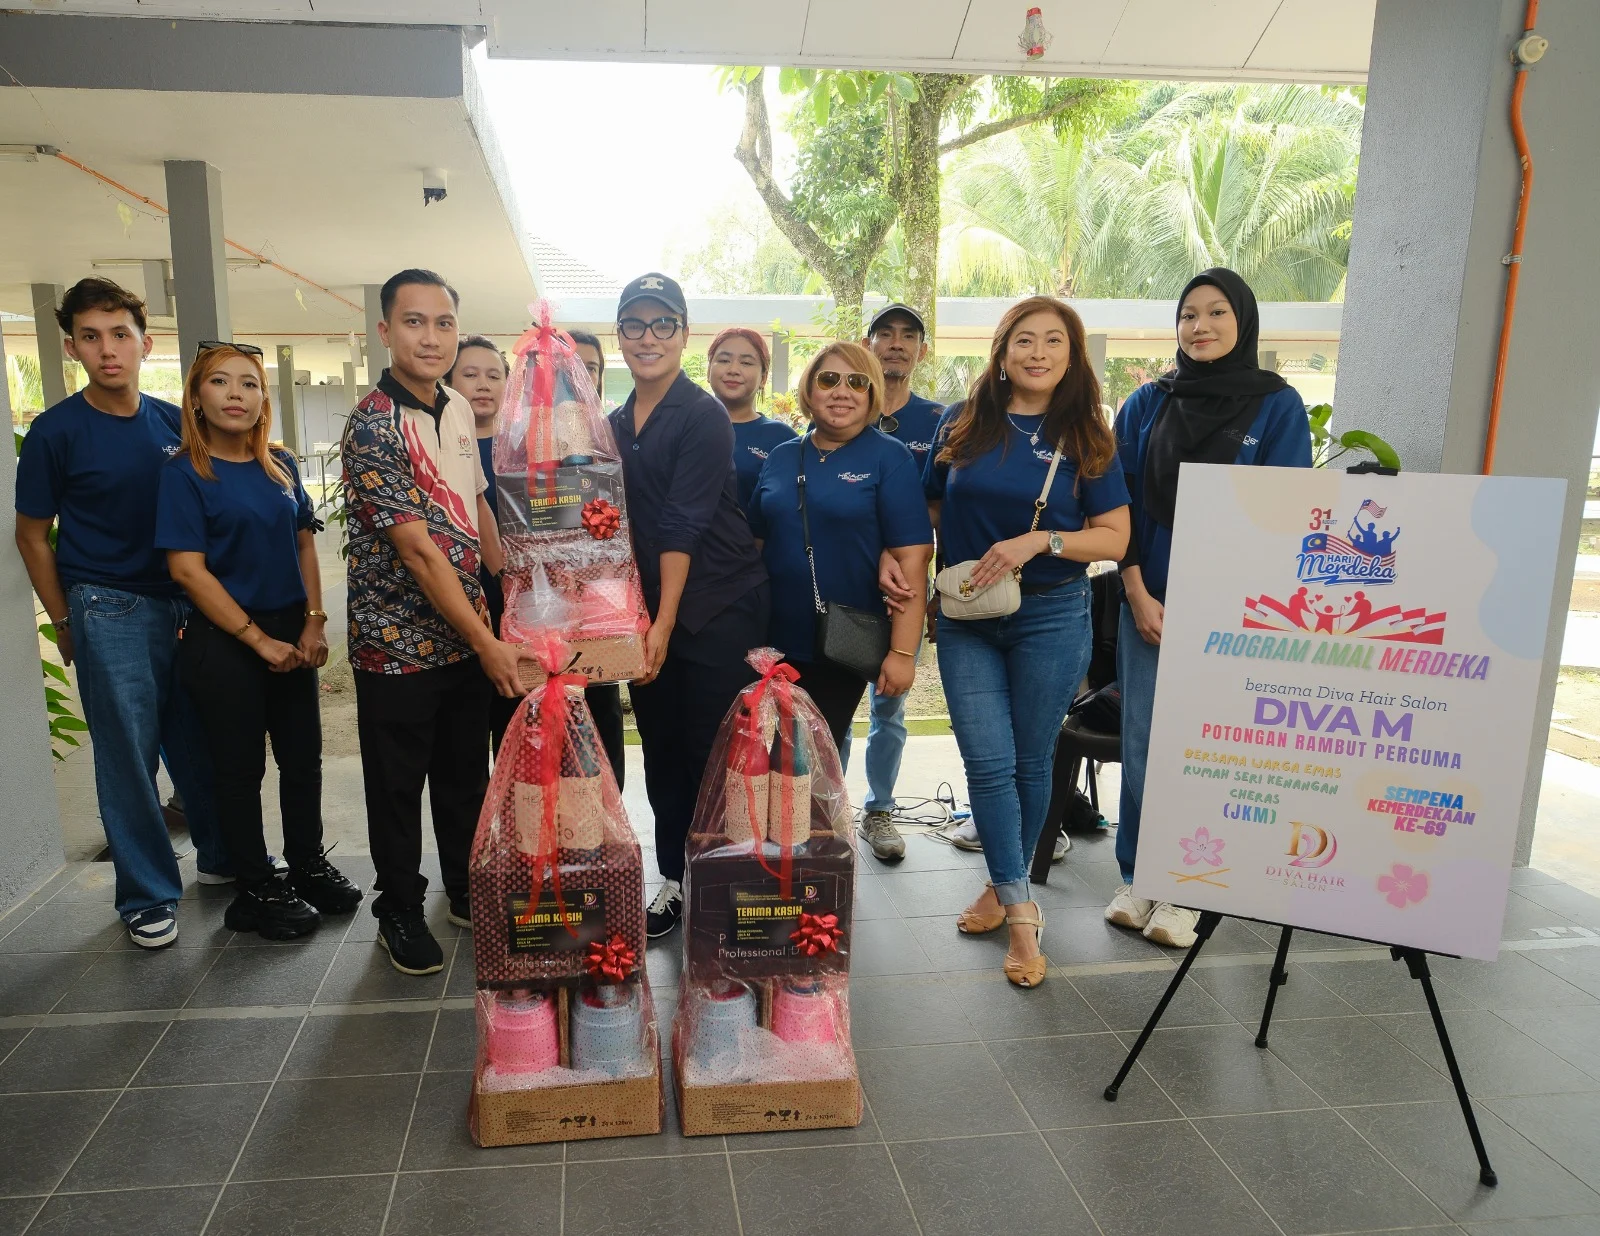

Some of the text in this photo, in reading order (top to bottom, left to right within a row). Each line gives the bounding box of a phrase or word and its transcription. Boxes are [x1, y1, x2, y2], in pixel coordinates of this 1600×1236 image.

[530, 497, 557, 508] TERIMA
[559, 494, 582, 505] KASIH
[1309, 507, 1332, 531] 31
[1296, 553, 1397, 579] Merdeka
[1327, 554, 1352, 564] HARI
[1203, 631, 1490, 680] PROGRAM AMAL MERDEKA
[1245, 678, 1448, 712] bersama Diva Hair Salon
[1253, 697, 1414, 742] DIVA M
[1202, 723, 1462, 770] POTONGAN RAMBUT PERCUMA
[1183, 748, 1342, 778] BERSAMA WARGA EMAS
[1183, 765, 1339, 795] RUMAH SERI KENANGAN
[1229, 788, 1280, 804] CHERAS
[1384, 785, 1464, 810] SEMPENA
[1223, 802, 1277, 824] (JKM)
[1367, 798, 1476, 825] KEMERDEKAAN
[1393, 815, 1447, 837] KE-69
[1265, 865, 1347, 888] DIVA HAIR
[1282, 879, 1327, 893] SALON
[514, 913, 551, 925] TEIMA
[736, 905, 803, 917] TERIMA KASIH
[505, 956, 574, 969] Professional
[718, 946, 786, 959] Professional
